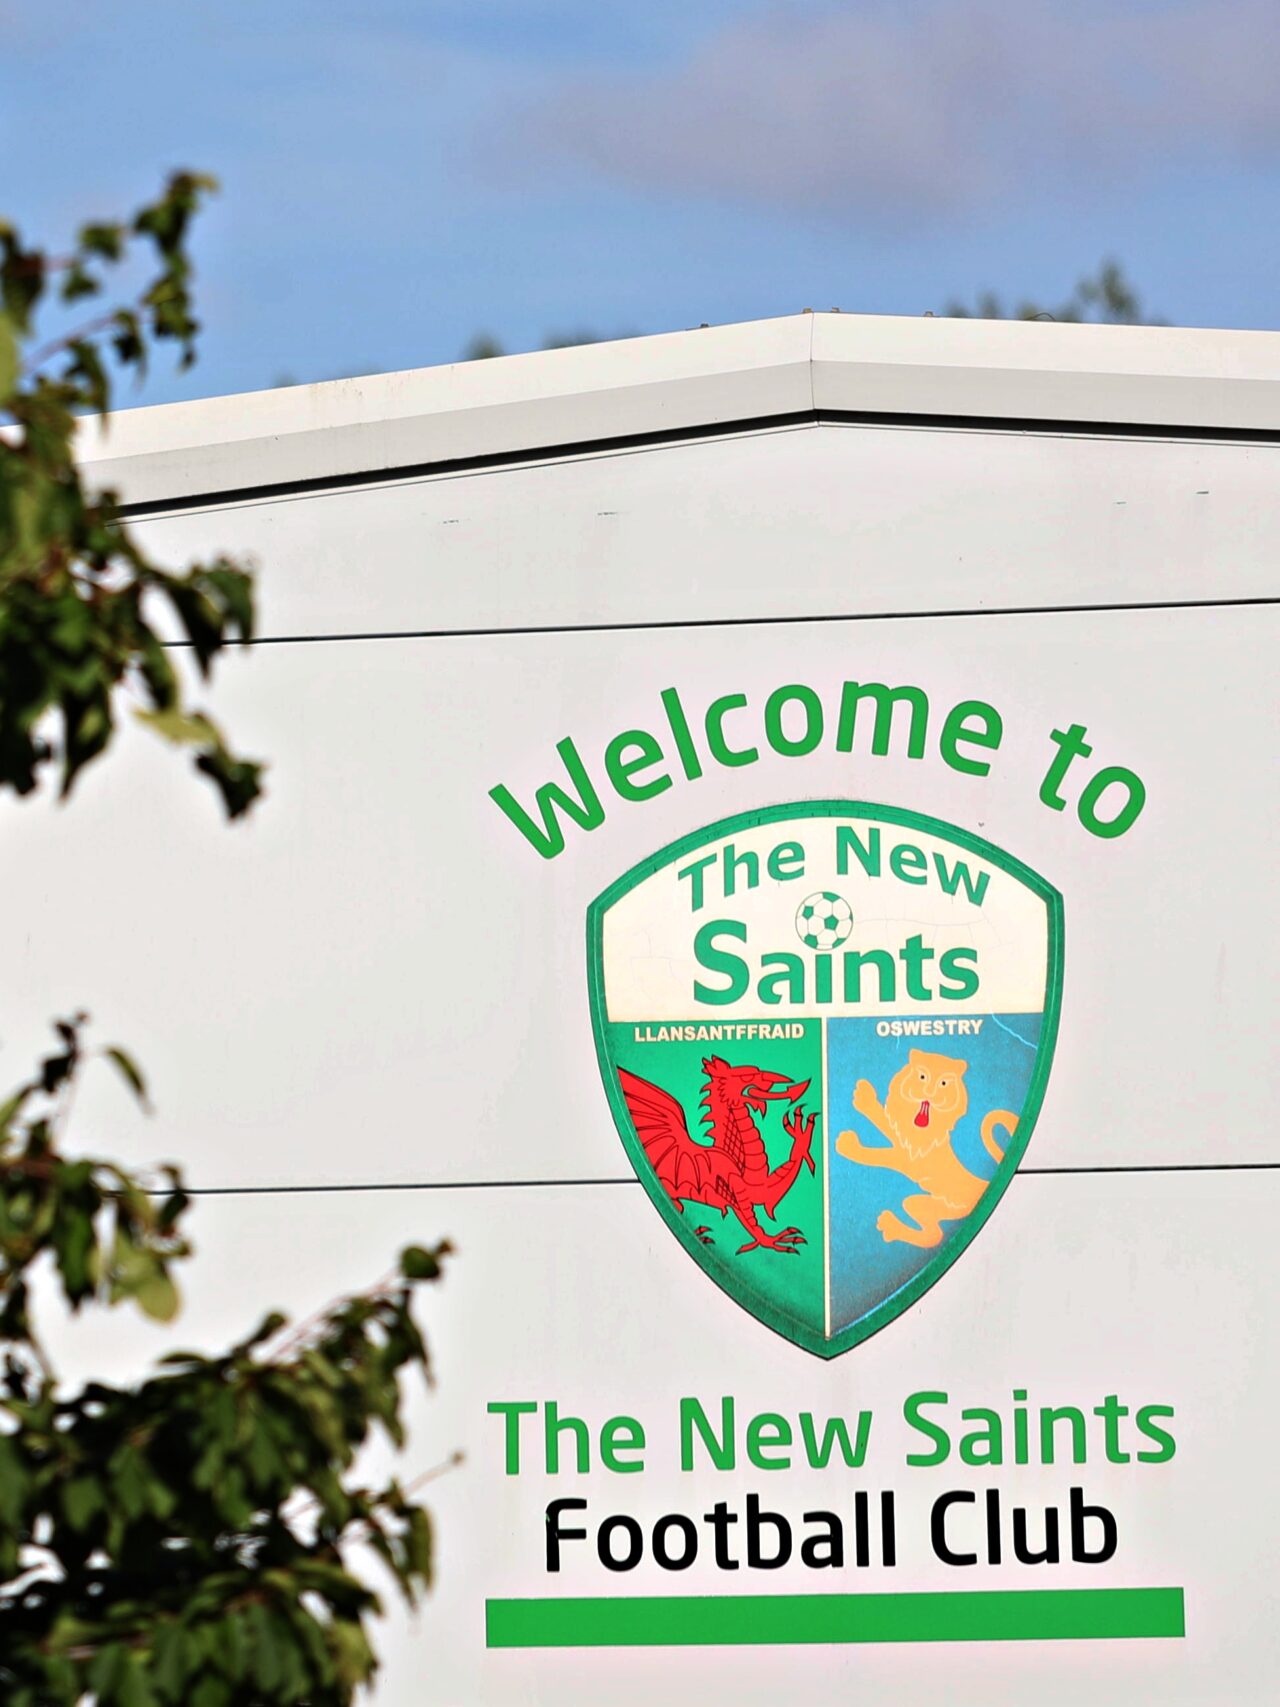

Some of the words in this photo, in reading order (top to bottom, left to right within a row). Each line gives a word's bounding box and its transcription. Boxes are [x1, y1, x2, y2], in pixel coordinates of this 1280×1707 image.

[488, 681, 1003, 860] Welcome
[1038, 723, 1147, 839] to
[677, 840, 806, 912] The
[835, 826, 992, 907] New
[693, 919, 980, 1006] Saints
[634, 1023, 805, 1043] LLANSANTFFRAID
[876, 1019, 984, 1037] OSWESTRY
[487, 1400, 646, 1475] The
[680, 1396, 873, 1471] New
[902, 1389, 1177, 1467] Saints
[545, 1490, 896, 1572] Football
[930, 1487, 1118, 1566] Club
